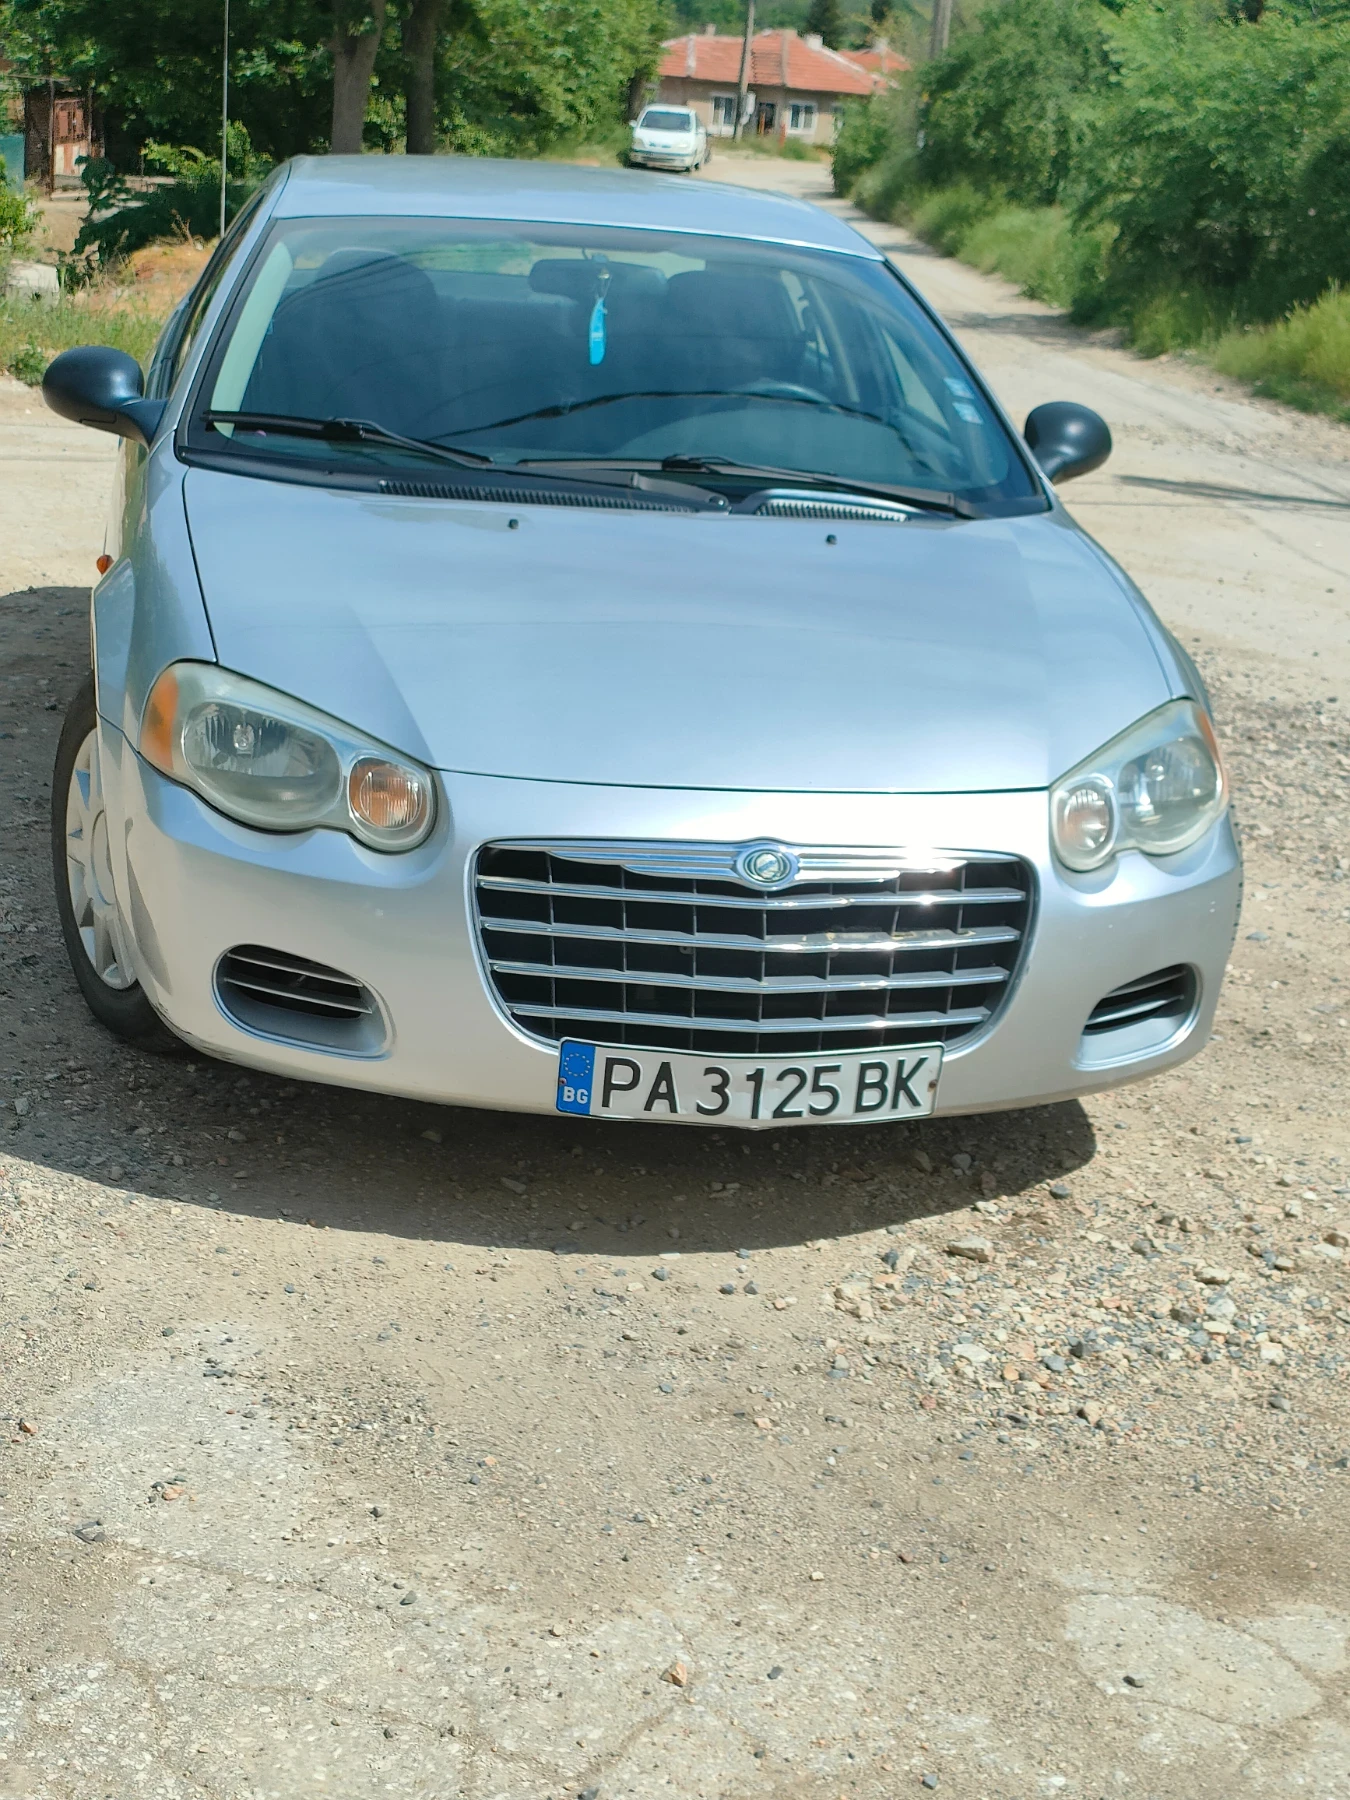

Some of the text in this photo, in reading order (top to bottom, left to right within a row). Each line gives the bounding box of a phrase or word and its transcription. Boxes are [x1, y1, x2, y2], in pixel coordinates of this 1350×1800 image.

[562, 1086, 588, 1104] BG
[601, 1056, 929, 1119] PA 3125 BK
